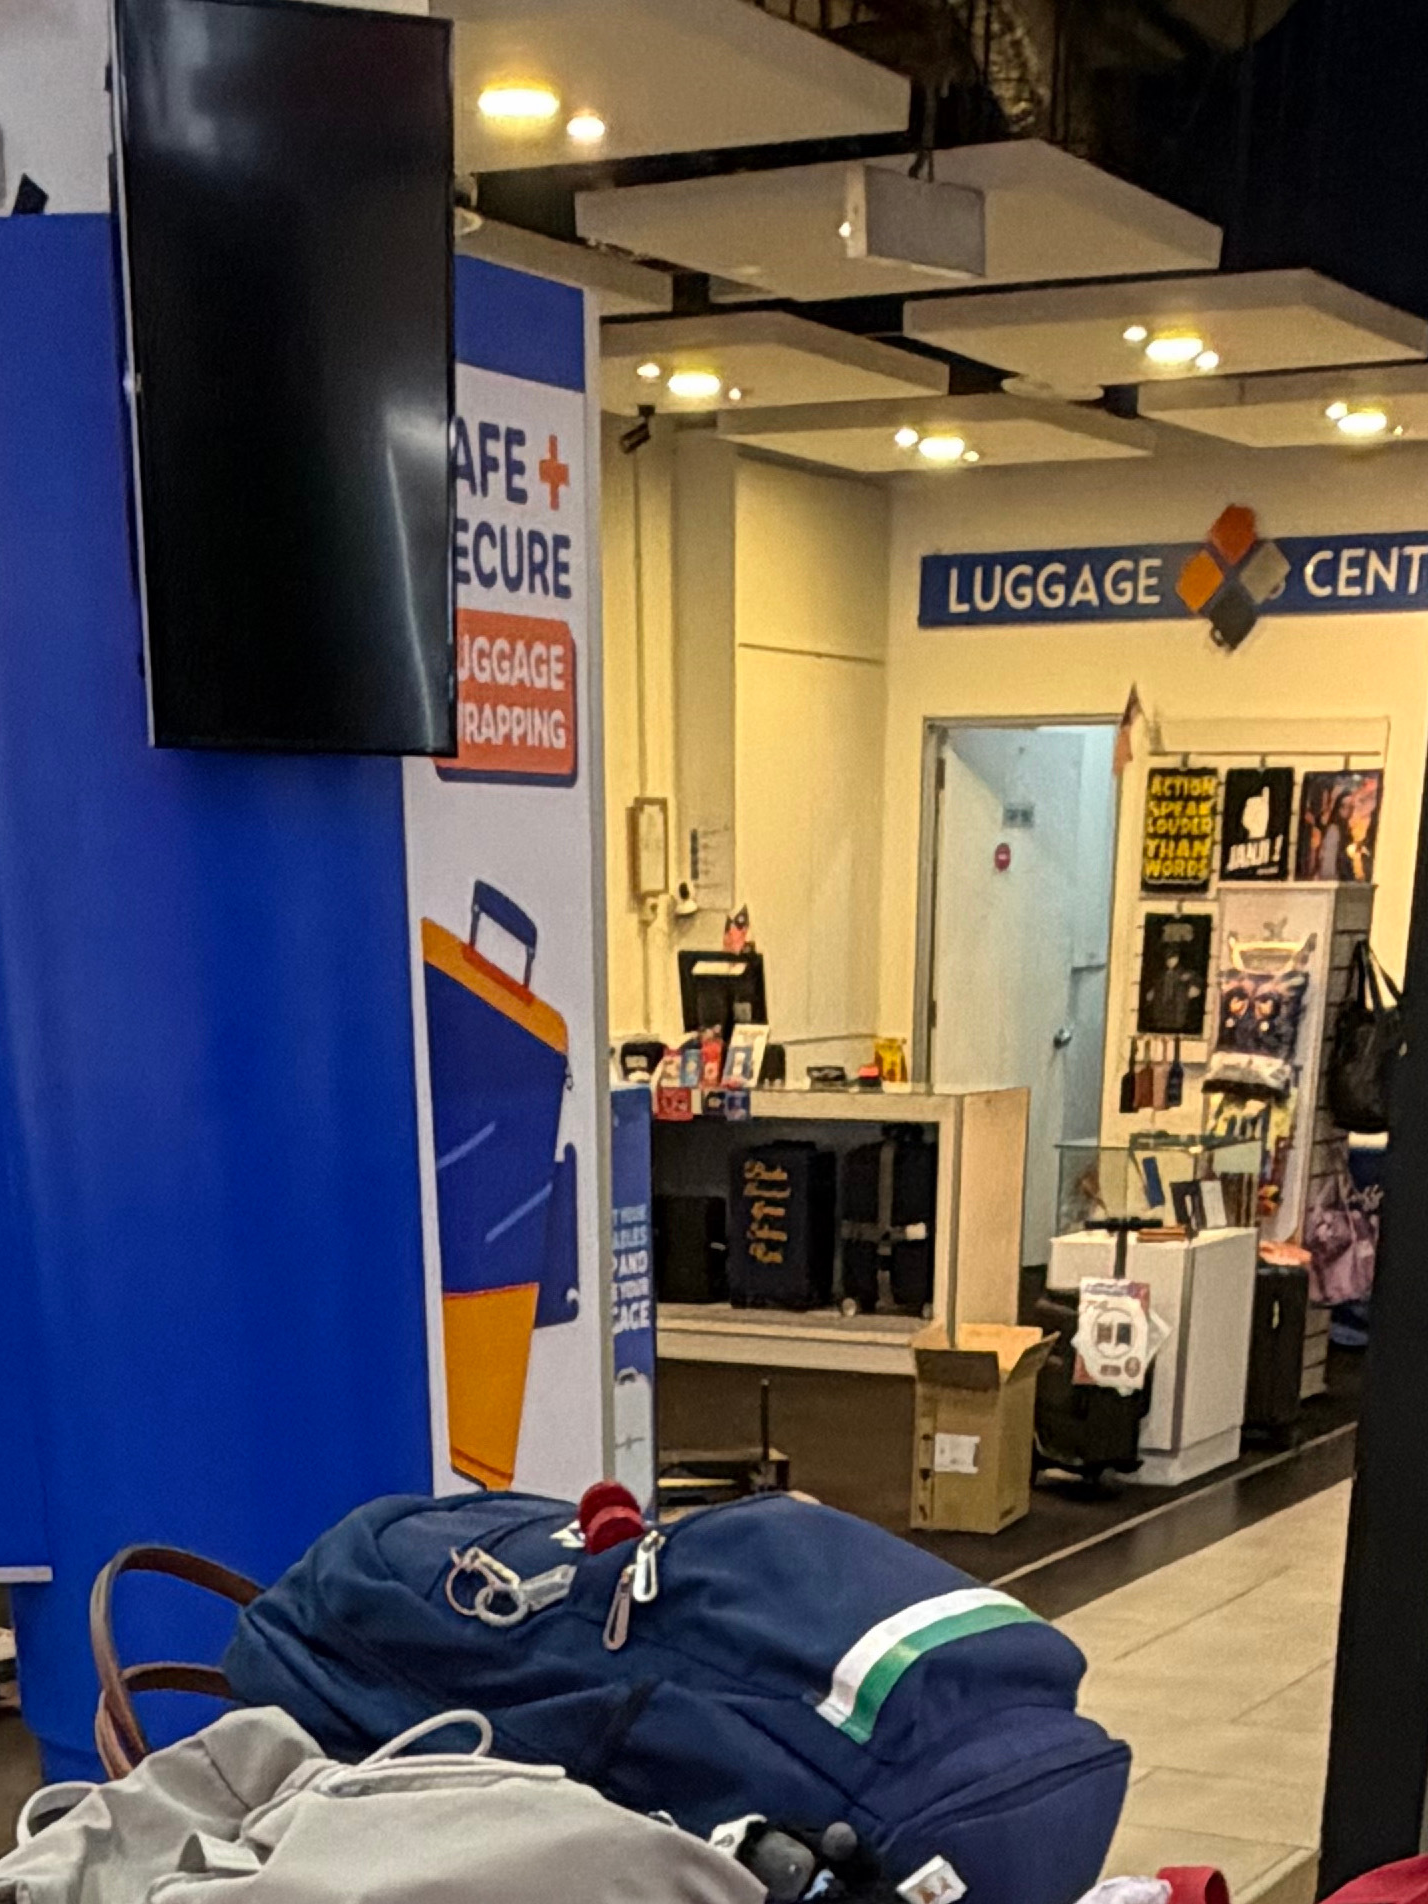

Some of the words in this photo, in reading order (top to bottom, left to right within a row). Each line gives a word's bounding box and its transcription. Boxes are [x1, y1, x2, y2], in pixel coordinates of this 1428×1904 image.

[452, 416, 528, 505] AFE
[454, 518, 572, 600] ECURE
[948, 557, 1163, 614] LUGGAGE
[457, 633, 566, 692] UGGAGE
[457, 702, 567, 750] RAPPING
[1150, 774, 1217, 797] ACTION
[1144, 858, 1209, 880] WORDS
[1146, 838, 1211, 858] THAN
